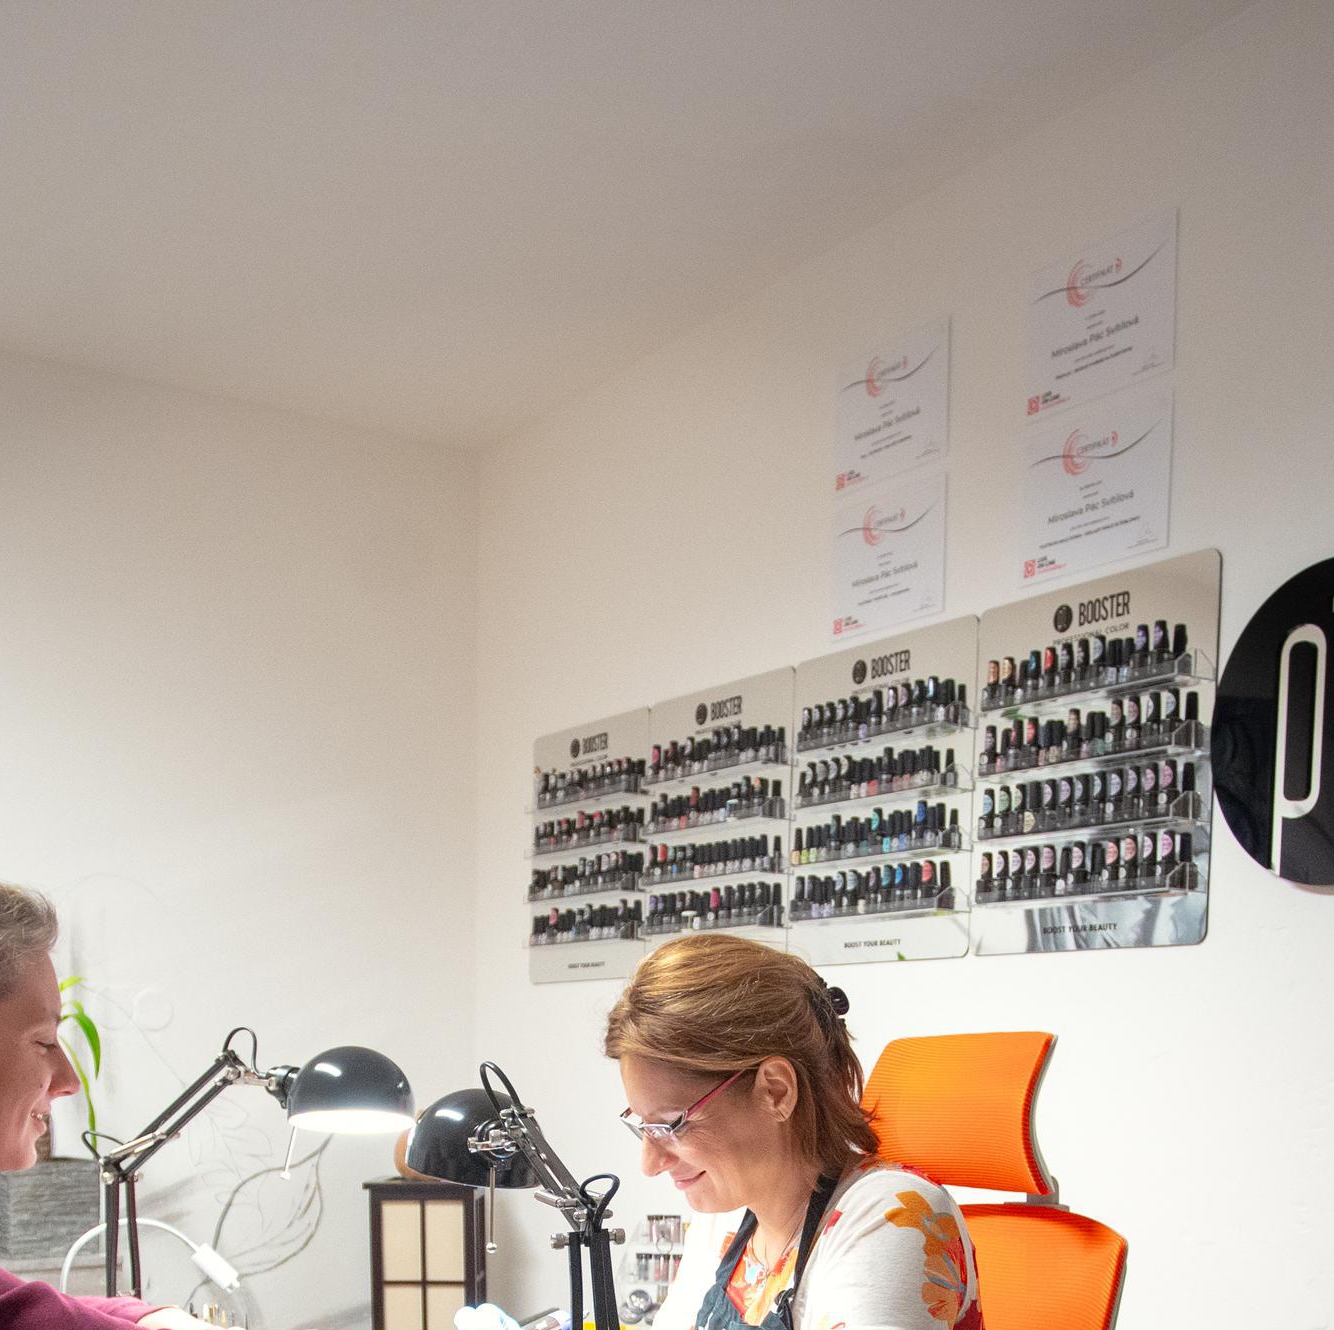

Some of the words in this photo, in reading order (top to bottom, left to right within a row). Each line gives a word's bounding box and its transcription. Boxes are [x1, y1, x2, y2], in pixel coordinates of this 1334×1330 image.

[1078, 590, 1131, 627] BOOSTER
[871, 649, 911, 679] BOOSTER
[711, 695, 742, 721] BOOSTER
[1043, 925, 1066, 935] BOOST
[1089, 923, 1118, 932] BEAUTY
